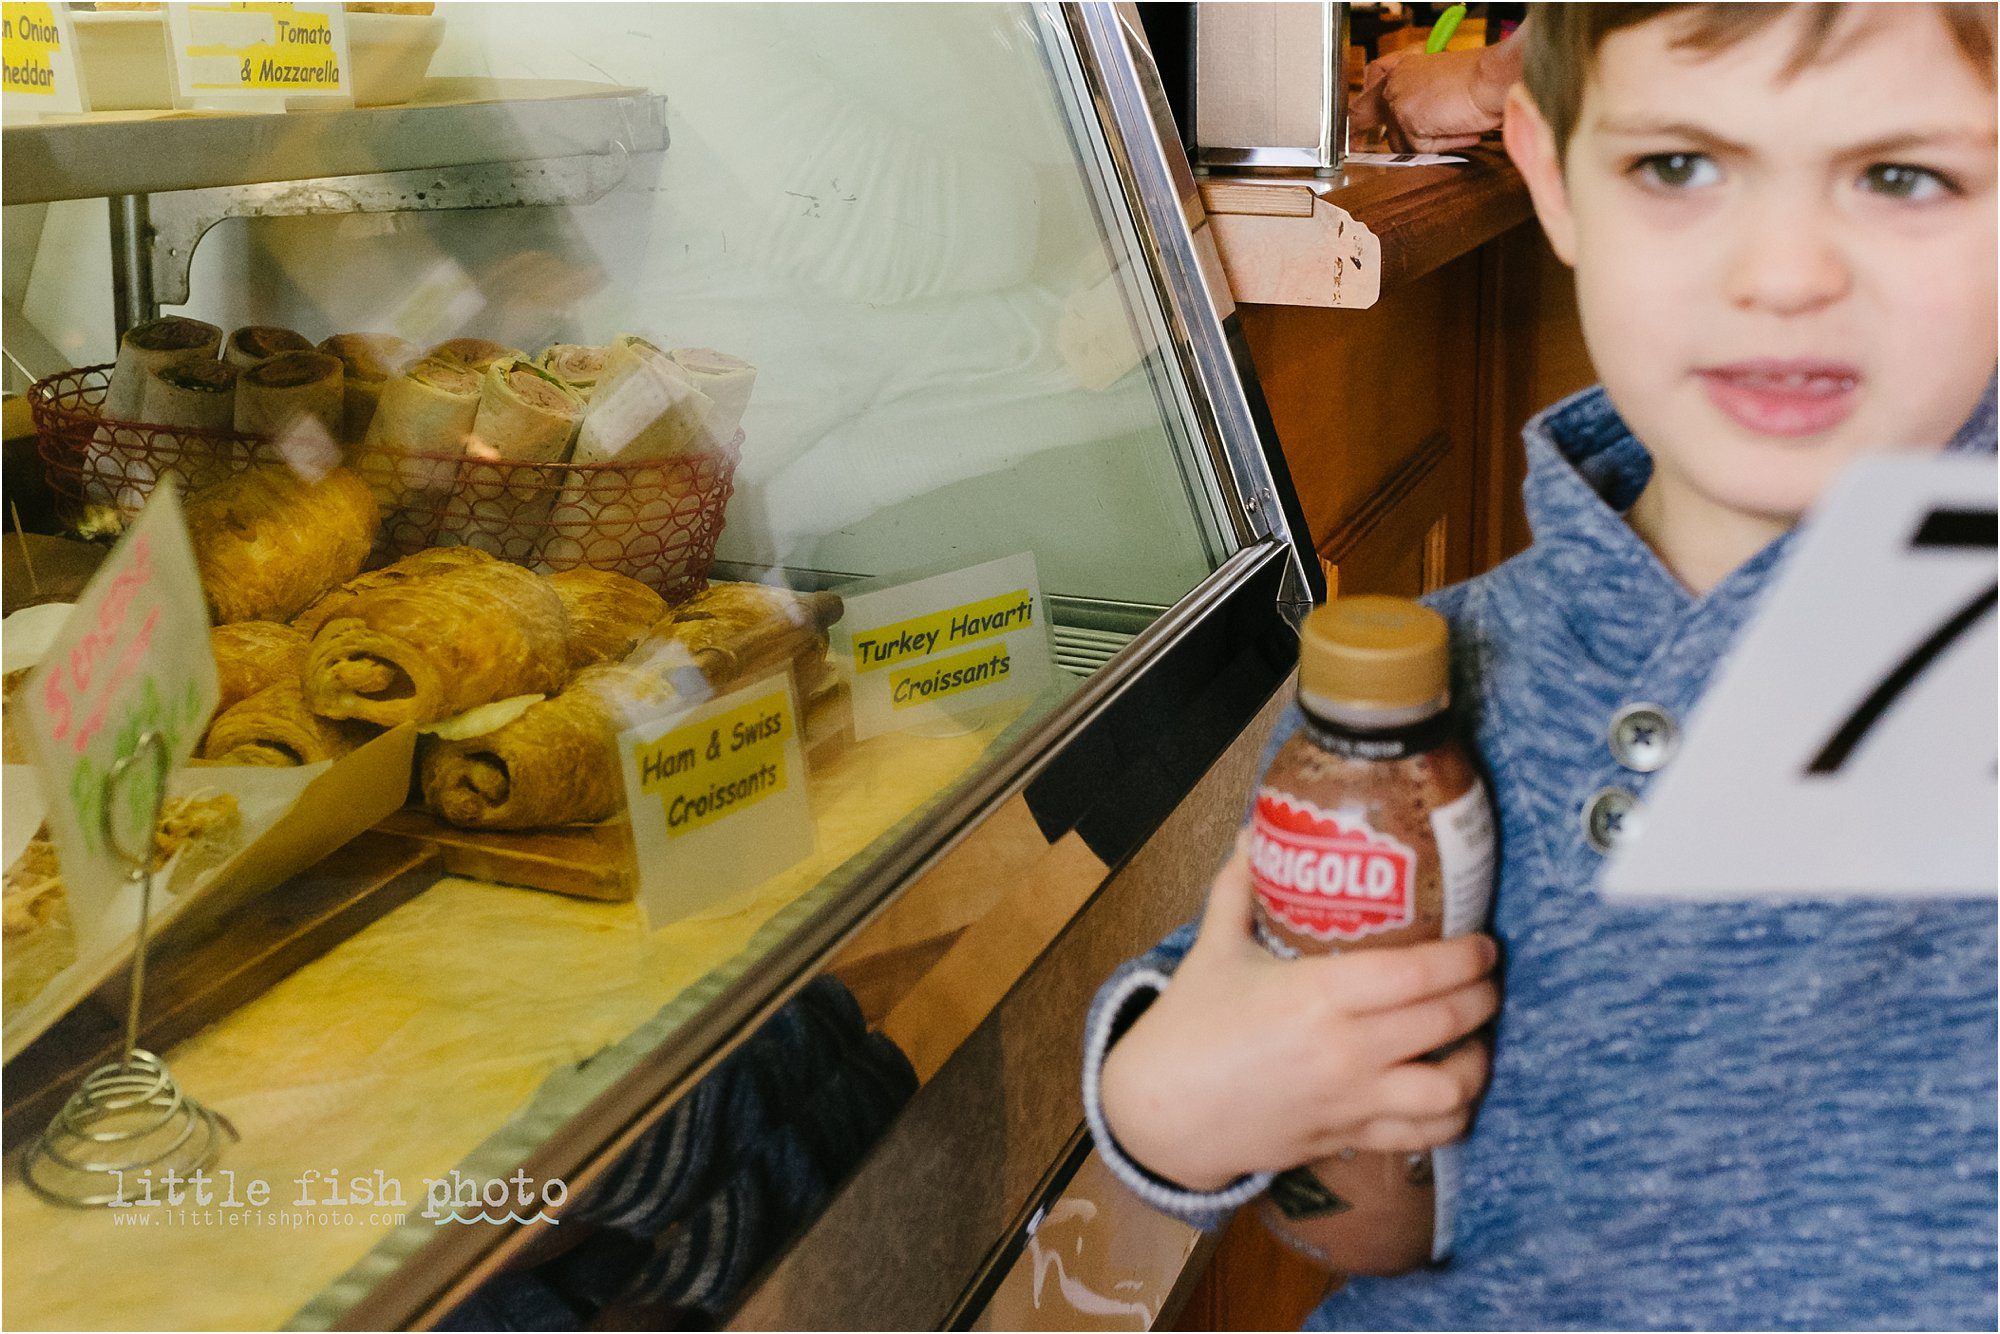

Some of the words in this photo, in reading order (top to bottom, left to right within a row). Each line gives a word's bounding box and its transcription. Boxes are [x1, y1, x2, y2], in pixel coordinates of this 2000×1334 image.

[19, 15, 60, 44] Onion
[278, 20, 332, 45] Tomato
[2, 56, 54, 87] heddar
[240, 58, 252, 82] &
[259, 59, 340, 84] Mozzarella
[858, 626, 940, 664] Turkey
[949, 597, 1034, 642] Havarti
[892, 654, 1011, 704] Croissants
[641, 745, 695, 786] Ham
[705, 730, 722, 762] &
[730, 710, 783, 753] Swiss
[667, 761, 777, 830] Croissants
